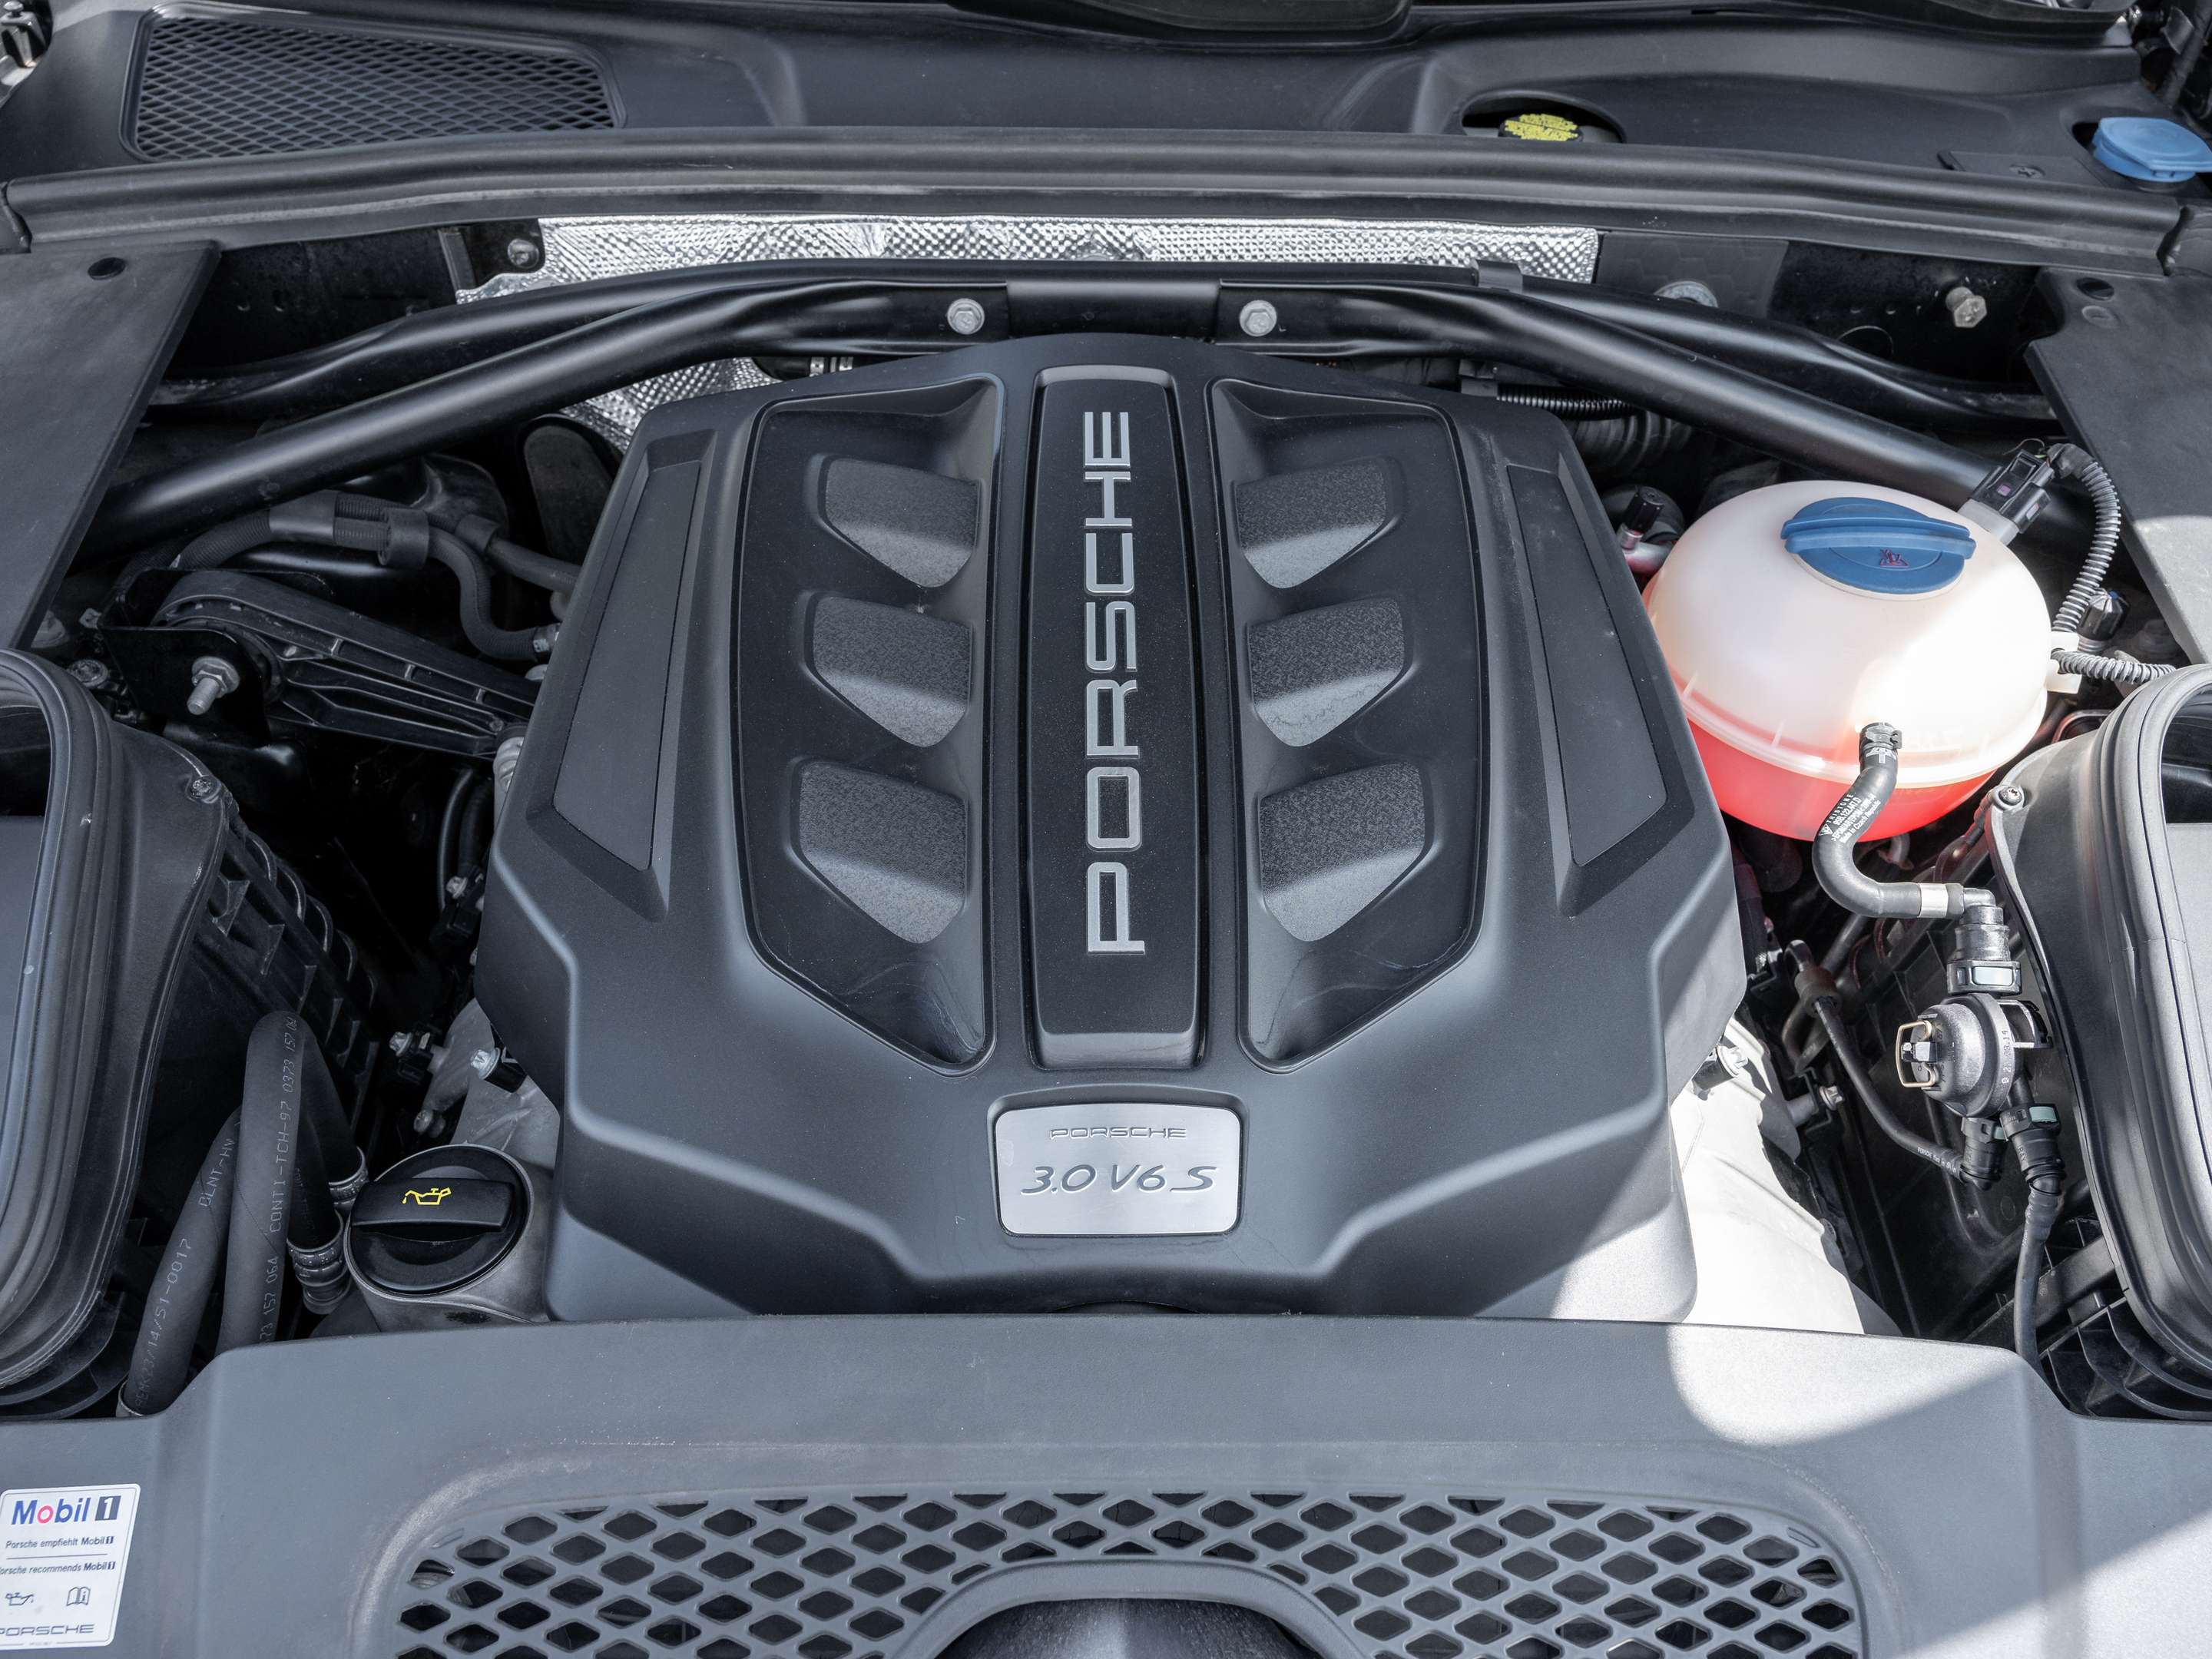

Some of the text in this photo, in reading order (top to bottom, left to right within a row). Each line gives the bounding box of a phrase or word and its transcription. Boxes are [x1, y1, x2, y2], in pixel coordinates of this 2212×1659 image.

[1084, 412, 1145, 955] PORSCHE
[1826, 793, 1854, 823] TRISTONE
[284, 1031, 296, 1052] 157
[282, 1058, 295, 1093] 0373
[1049, 1127, 1187, 1140] PORSCHE
[1020, 1164, 1218, 1196] 3.0 V6 S
[263, 1293, 276, 1316] 157
[11, 1498, 91, 1525] Mobil
[5, 1540, 38, 1549] Porsche
[40, 1538, 78, 1548] empfiehlt
[0, 1566, 26, 1575] orsche
[28, 1563, 81, 1574] recommends
